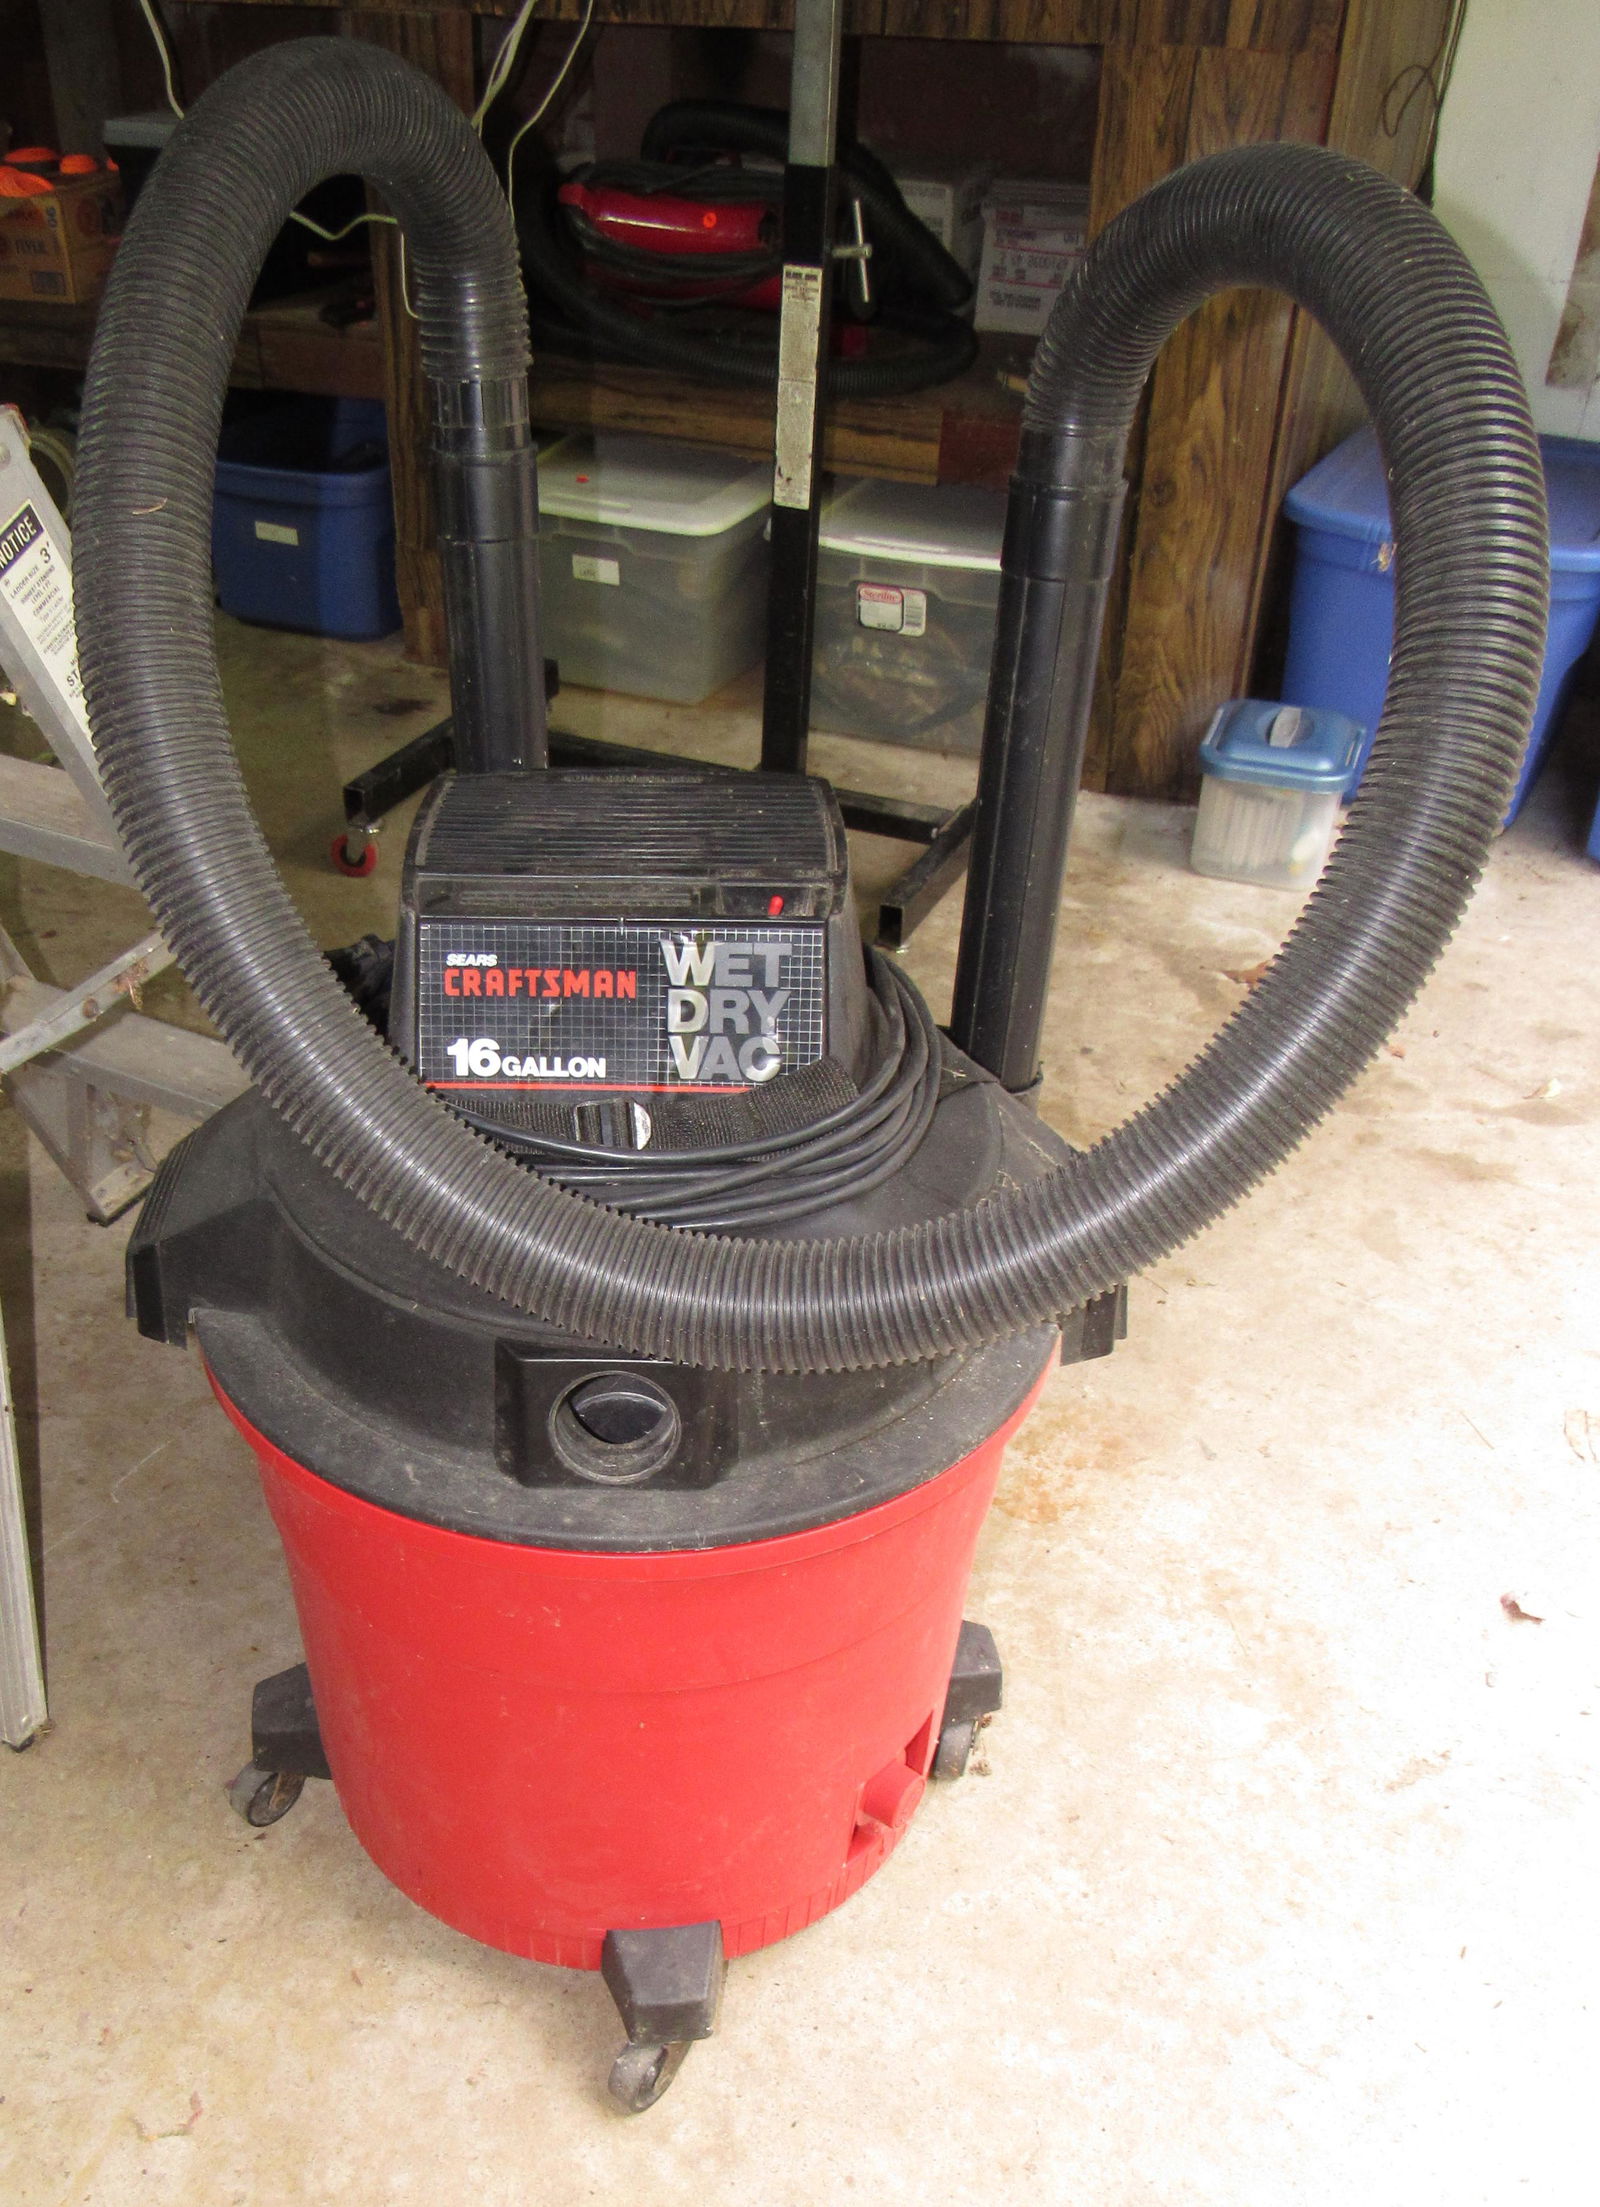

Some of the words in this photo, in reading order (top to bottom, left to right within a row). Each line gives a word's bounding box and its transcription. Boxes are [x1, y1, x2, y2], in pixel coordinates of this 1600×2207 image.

[10, 575, 30, 599] LADDER
[33, 585, 59, 617] COMMERCIAL
[863, 589, 897, 601] Sterilite
[446, 953, 498, 967] SEARS
[659, 939, 792, 988] WET
[444, 968, 637, 999] CRAFTSMAN
[667, 988, 792, 1035] DRY
[447, 1037, 502, 1077] 16
[501, 1055, 607, 1078] GALLON
[667, 1035, 783, 1082] VAC
